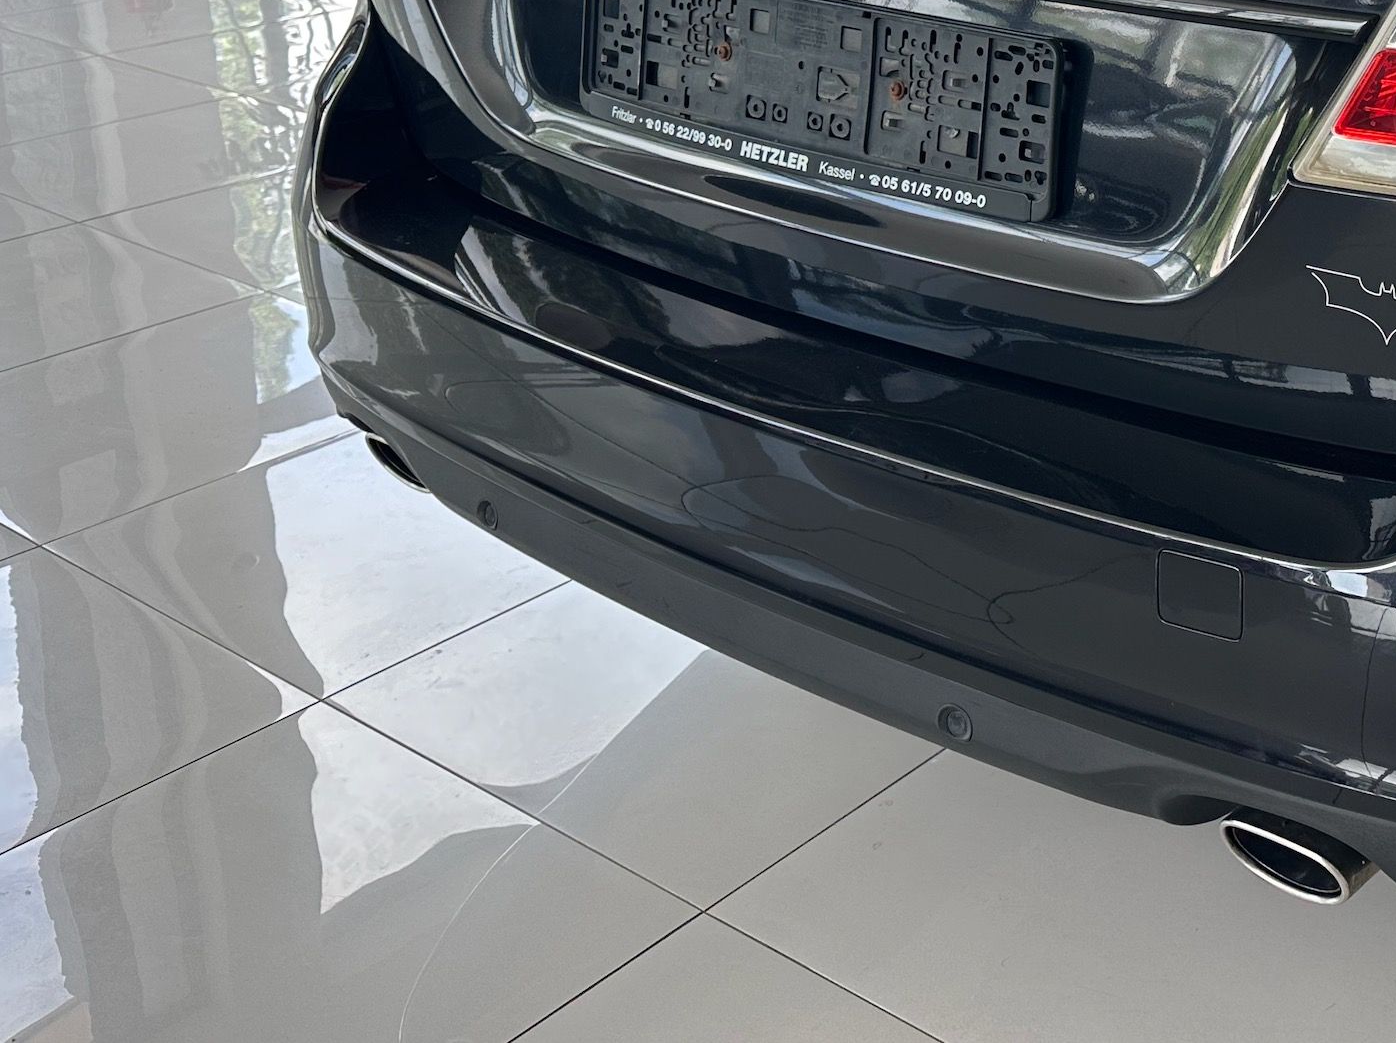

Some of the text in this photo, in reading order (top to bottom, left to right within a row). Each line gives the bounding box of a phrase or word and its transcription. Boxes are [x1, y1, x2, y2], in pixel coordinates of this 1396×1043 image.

[611, 105, 637, 125] Fritzlar
[662, 121, 676, 136] 56
[676, 125, 706, 145] 22/99
[707, 134, 733, 151] 30-0
[740, 140, 809, 172] HETZLER
[818, 161, 856, 182] Kassel
[881, 175, 899, 191] 05
[901, 179, 932, 198] 61/5
[934, 185, 952, 201] 70
[954, 190, 987, 208] 09-0
